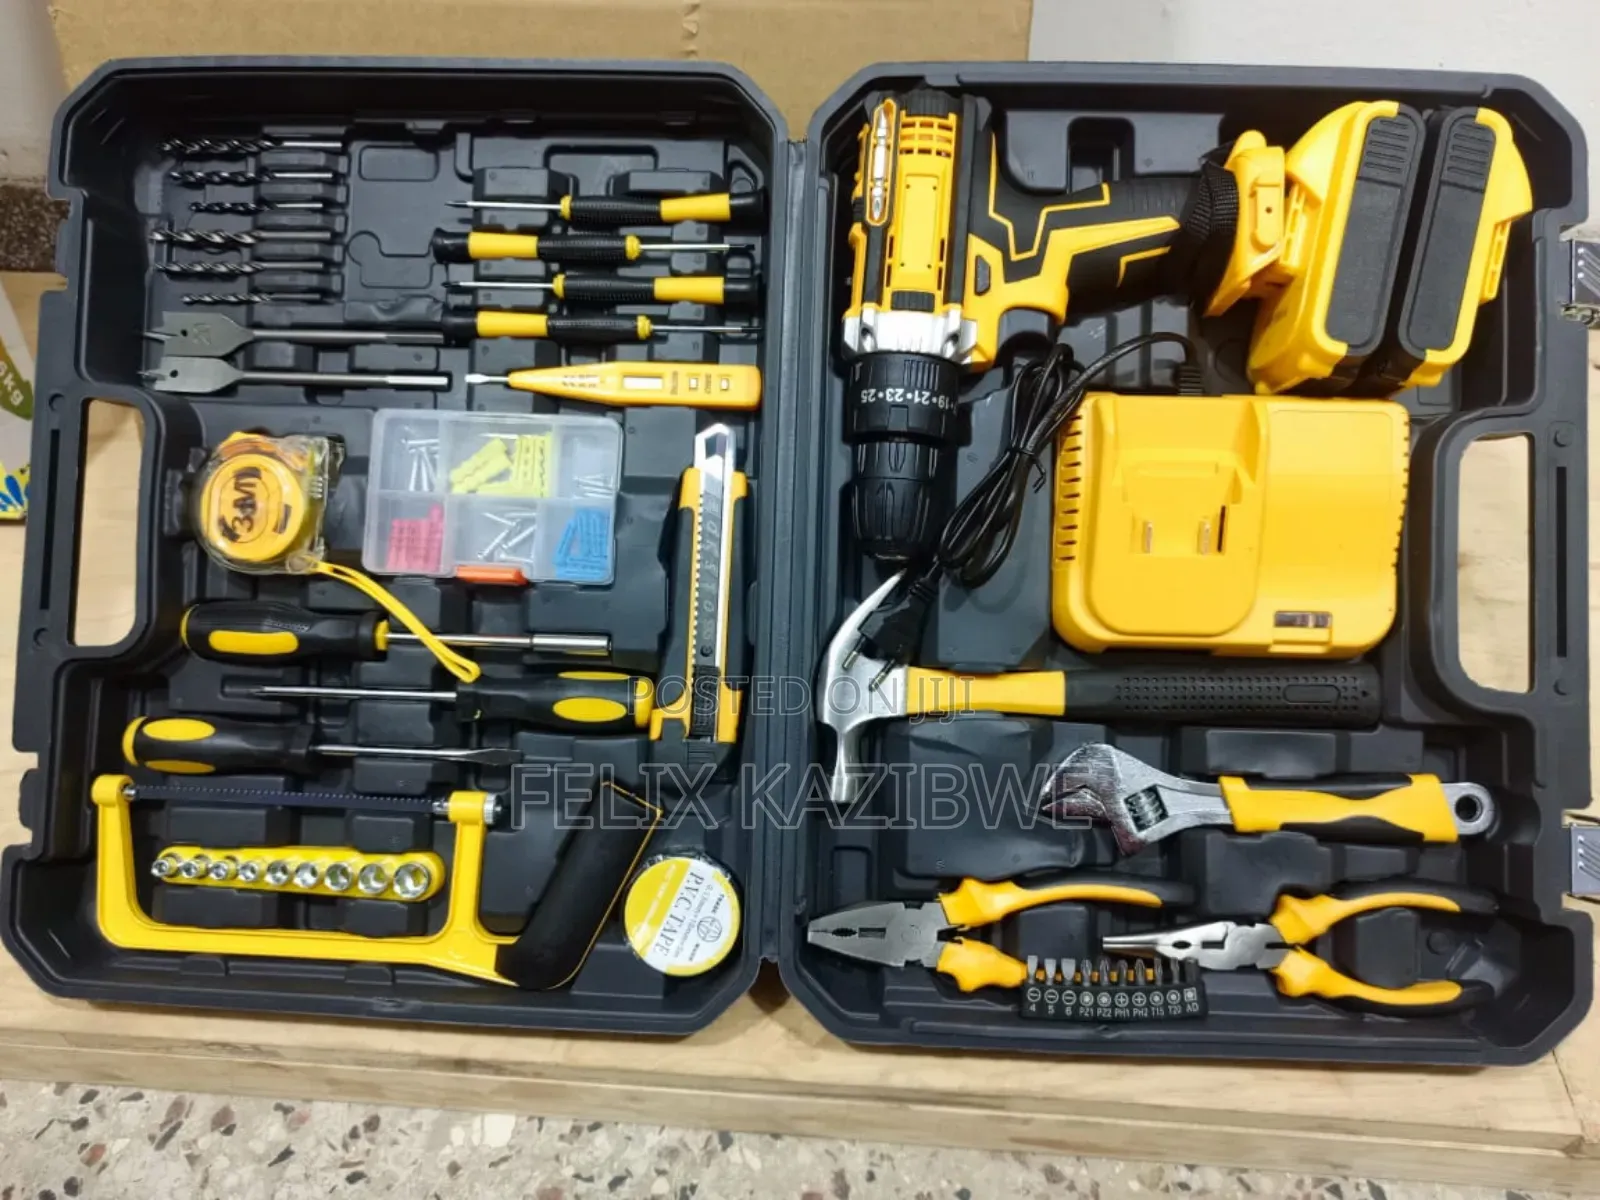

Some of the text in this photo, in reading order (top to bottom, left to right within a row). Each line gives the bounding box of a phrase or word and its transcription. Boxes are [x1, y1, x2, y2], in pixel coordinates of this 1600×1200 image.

[861, 388, 877, 404] 25
[885, 388, 905, 402] 23
[914, 389, 931, 405] 21
[655, 914, 686, 957] TAPE
[1079, 1007, 1094, 1017] PZ1
[1096, 1008, 1111, 1018] PZ2
